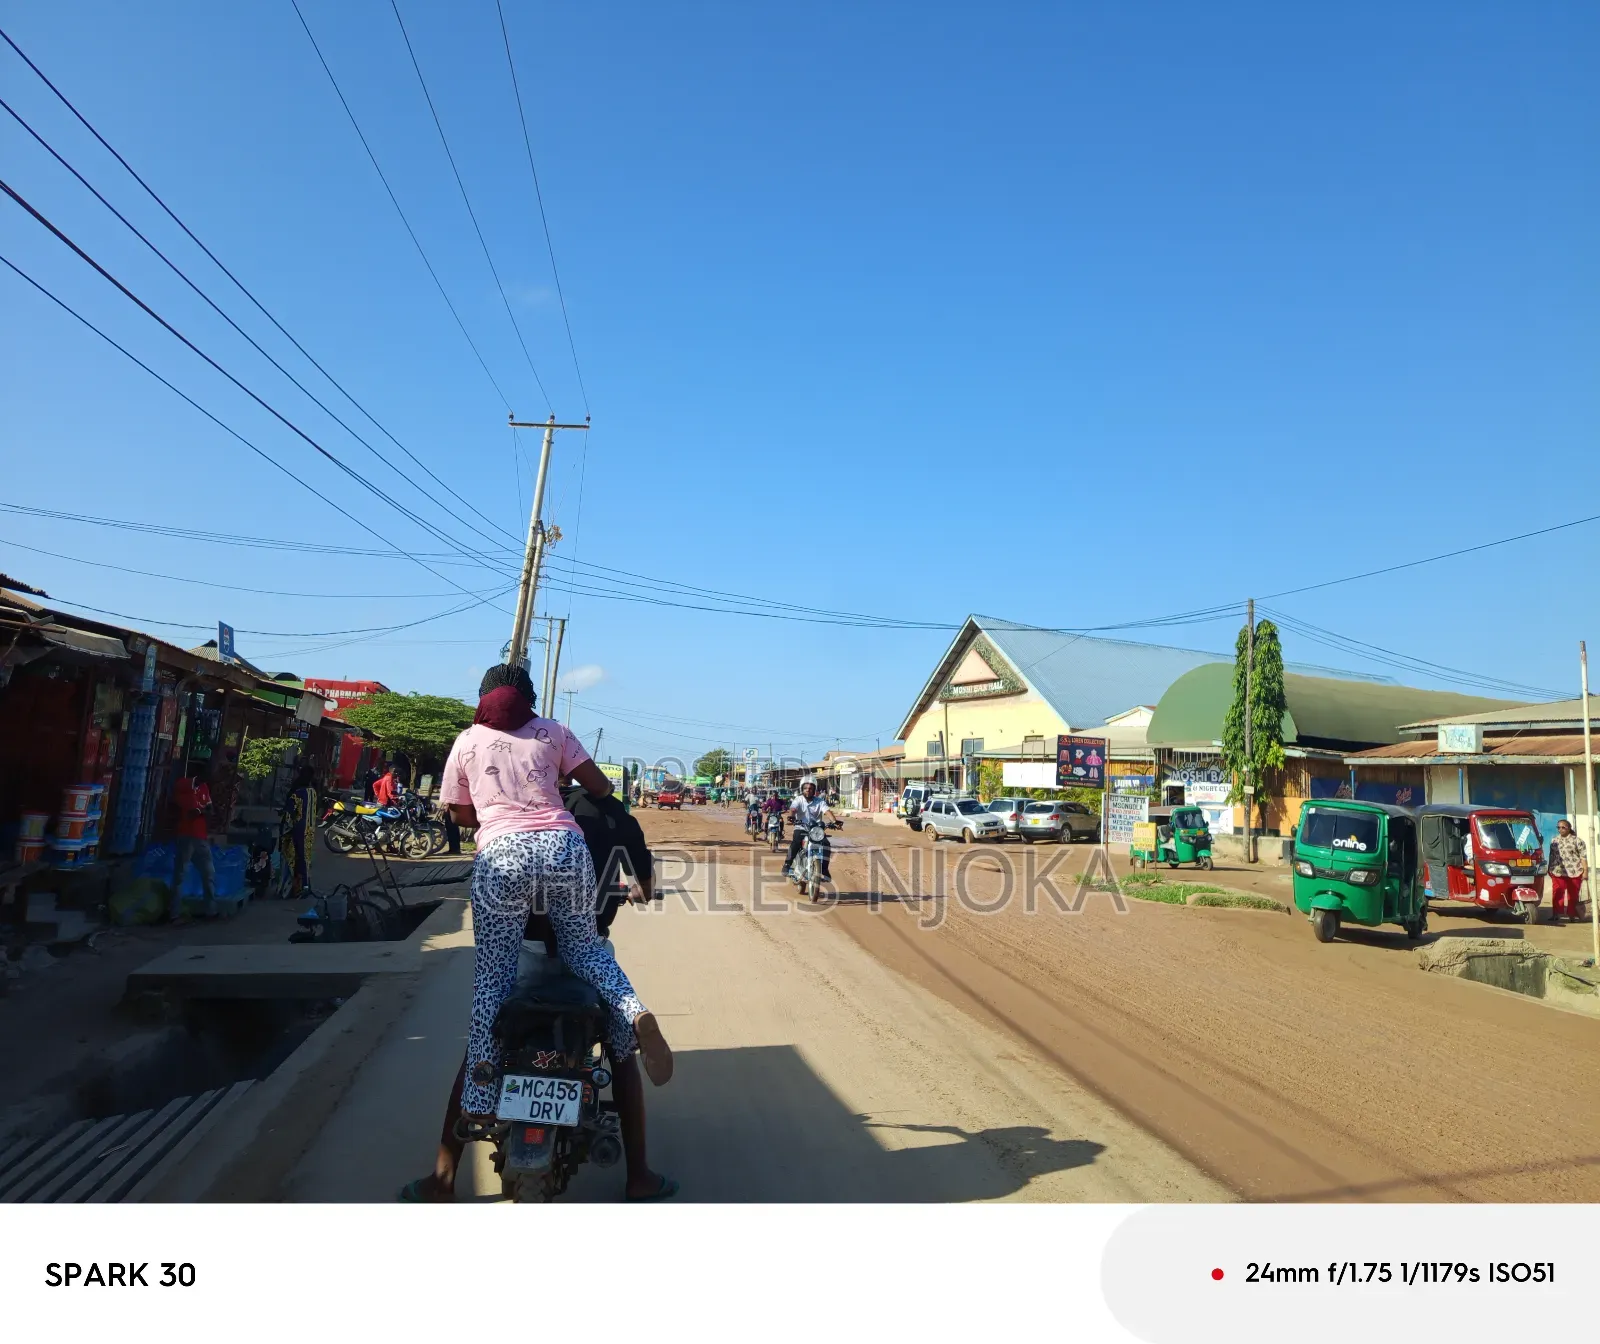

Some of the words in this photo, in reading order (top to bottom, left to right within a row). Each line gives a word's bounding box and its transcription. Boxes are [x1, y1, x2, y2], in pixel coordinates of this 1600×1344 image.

[953, 685, 973, 694] MOSHI
[989, 680, 1003, 691] HALL
[1171, 770, 1206, 782] MOSHI
[1333, 838, 1367, 851] online
[521, 1079, 578, 1101] MC456
[530, 1101, 565, 1120] DRV
